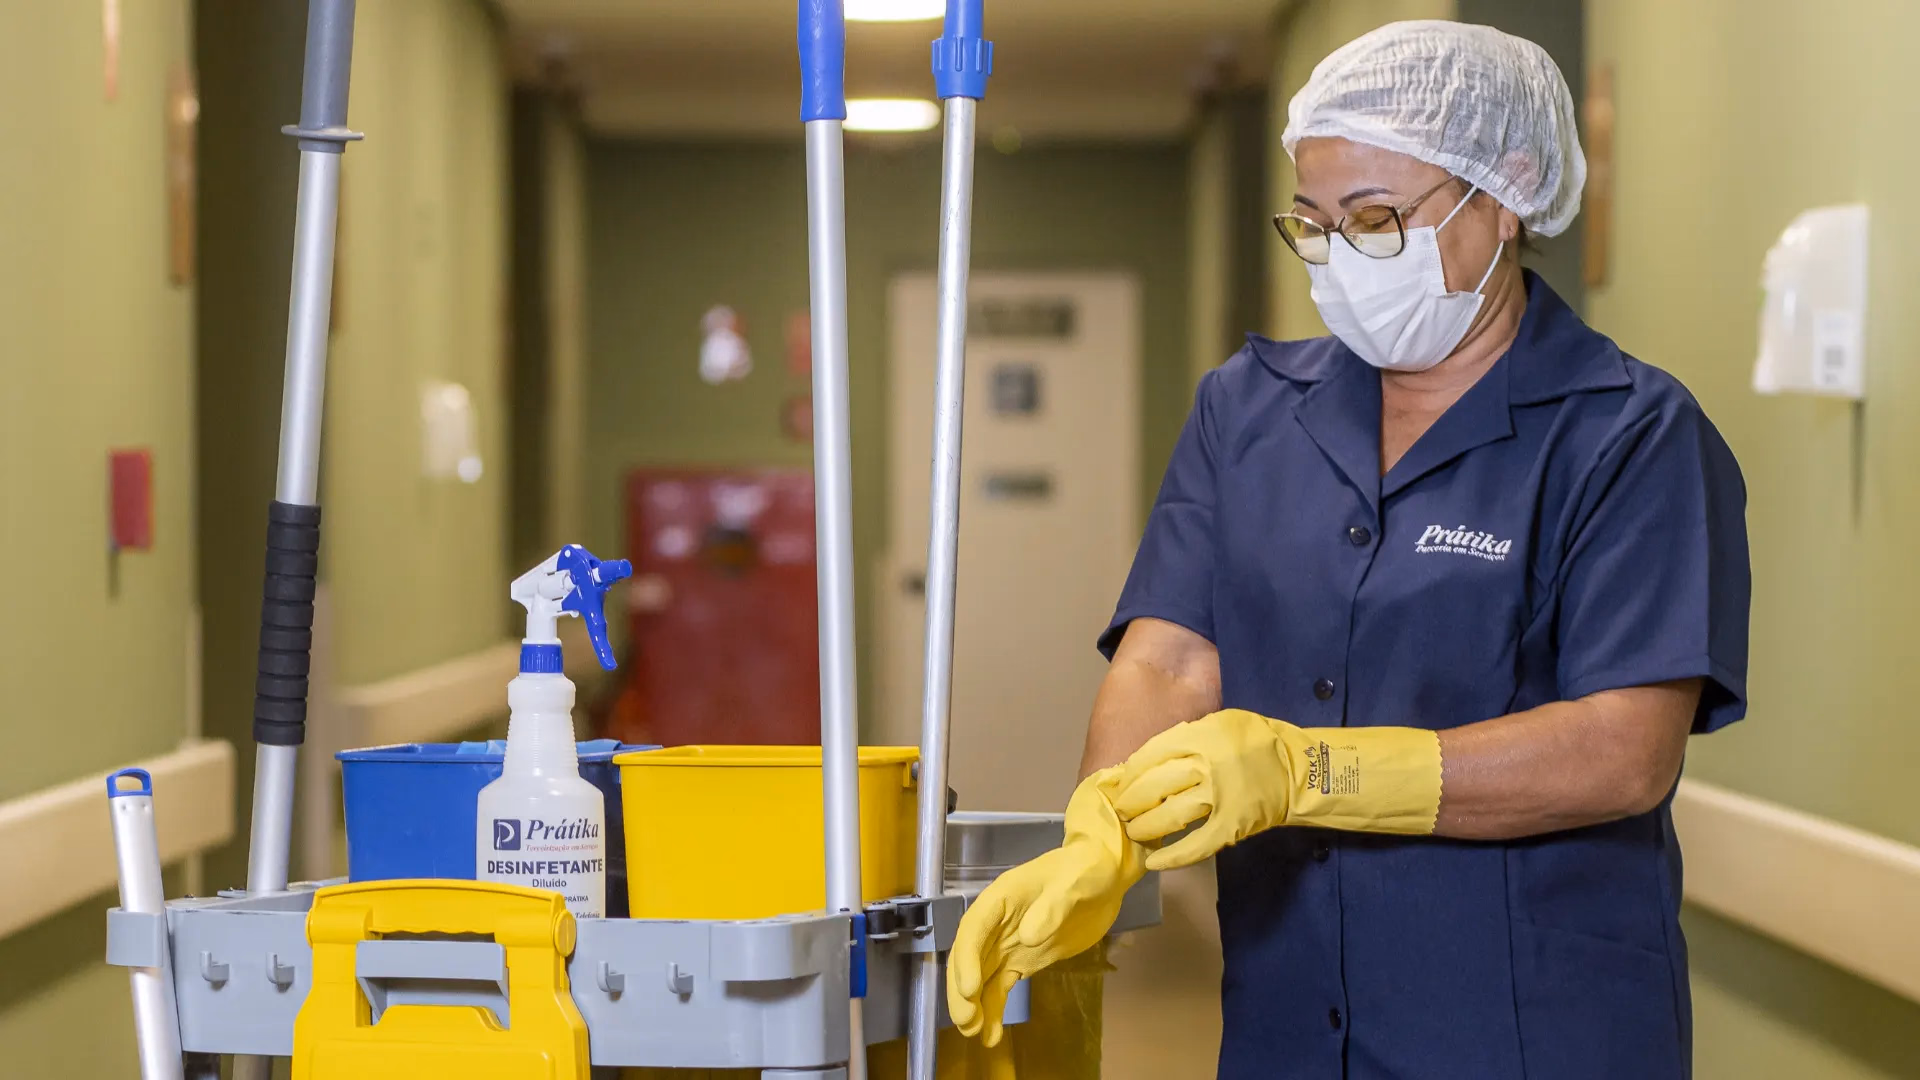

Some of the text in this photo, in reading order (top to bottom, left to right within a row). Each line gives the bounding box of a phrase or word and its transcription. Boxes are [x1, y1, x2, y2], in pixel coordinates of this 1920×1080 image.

[1414, 524, 1513, 555] Prátika
[1415, 544, 1506, 562] Parceria em Serviços
[1307, 760, 1318, 790] VOLK
[525, 817, 599, 840] Prátika
[487, 858, 603, 875] DESINFETANTE
[532, 878, 567, 888] Diluído
